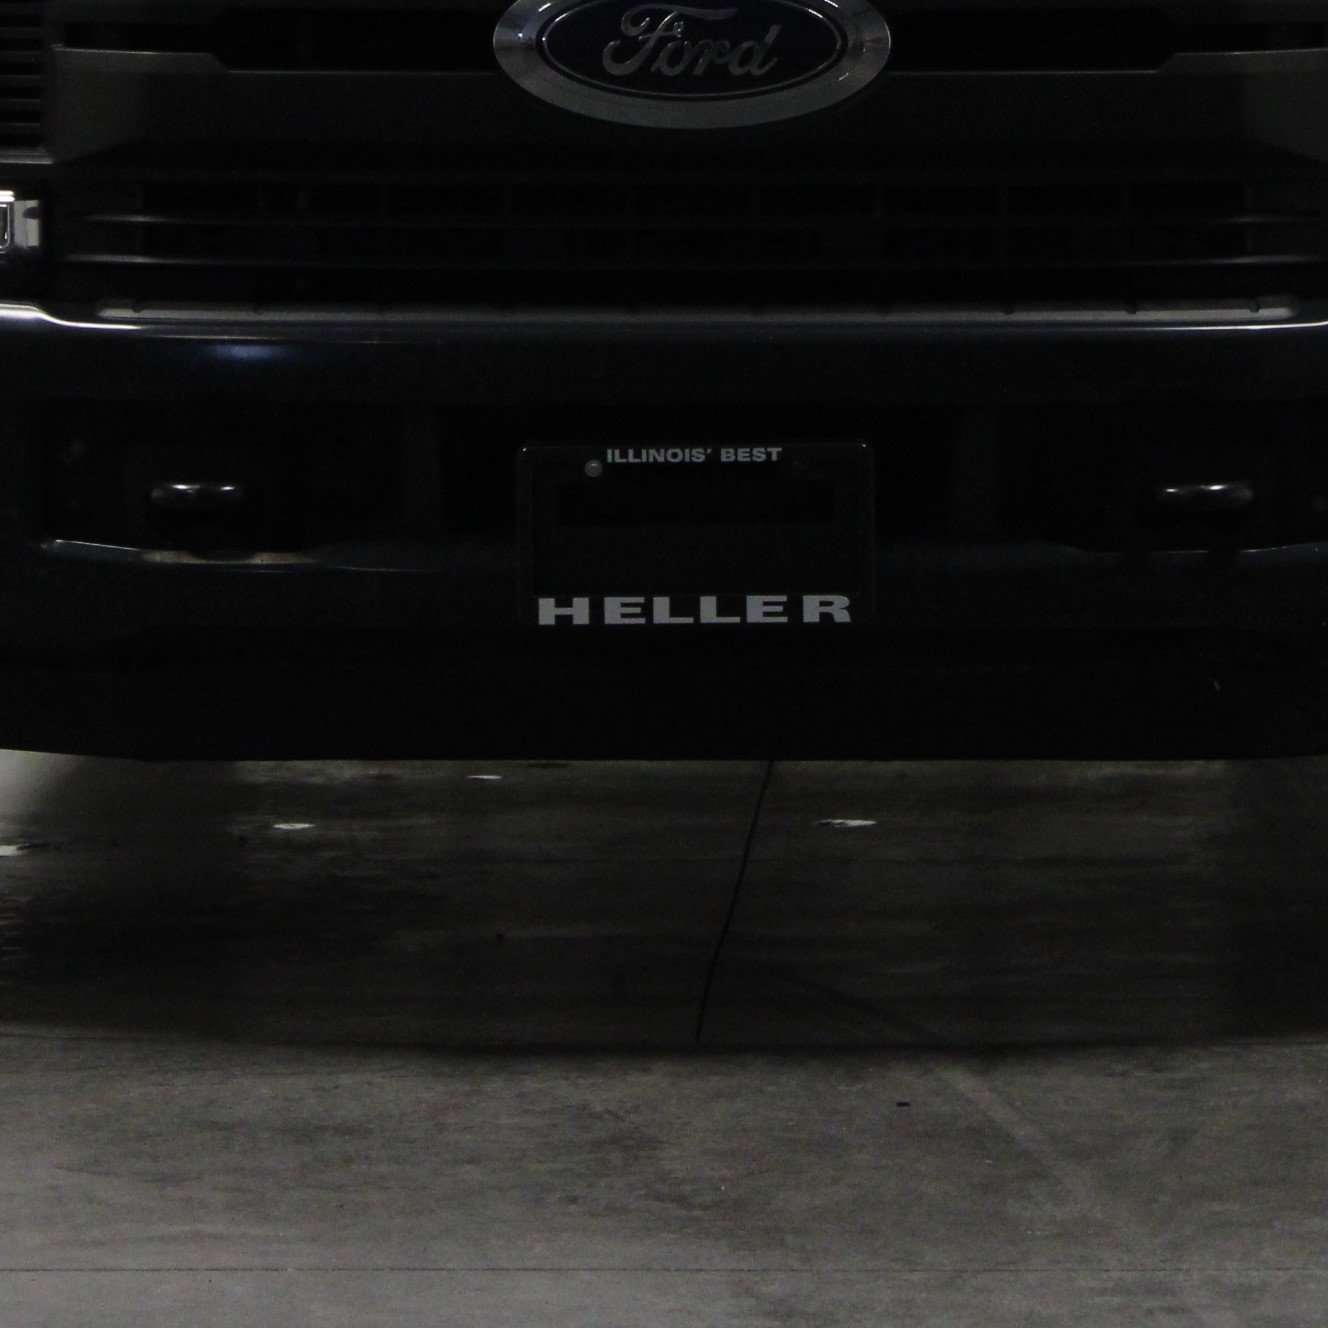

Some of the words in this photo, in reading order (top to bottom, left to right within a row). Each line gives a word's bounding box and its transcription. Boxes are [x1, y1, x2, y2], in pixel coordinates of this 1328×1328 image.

[602, 2, 781, 76] Ford
[720, 447, 782, 463] BEST
[538, 595, 851, 625] HELLER
